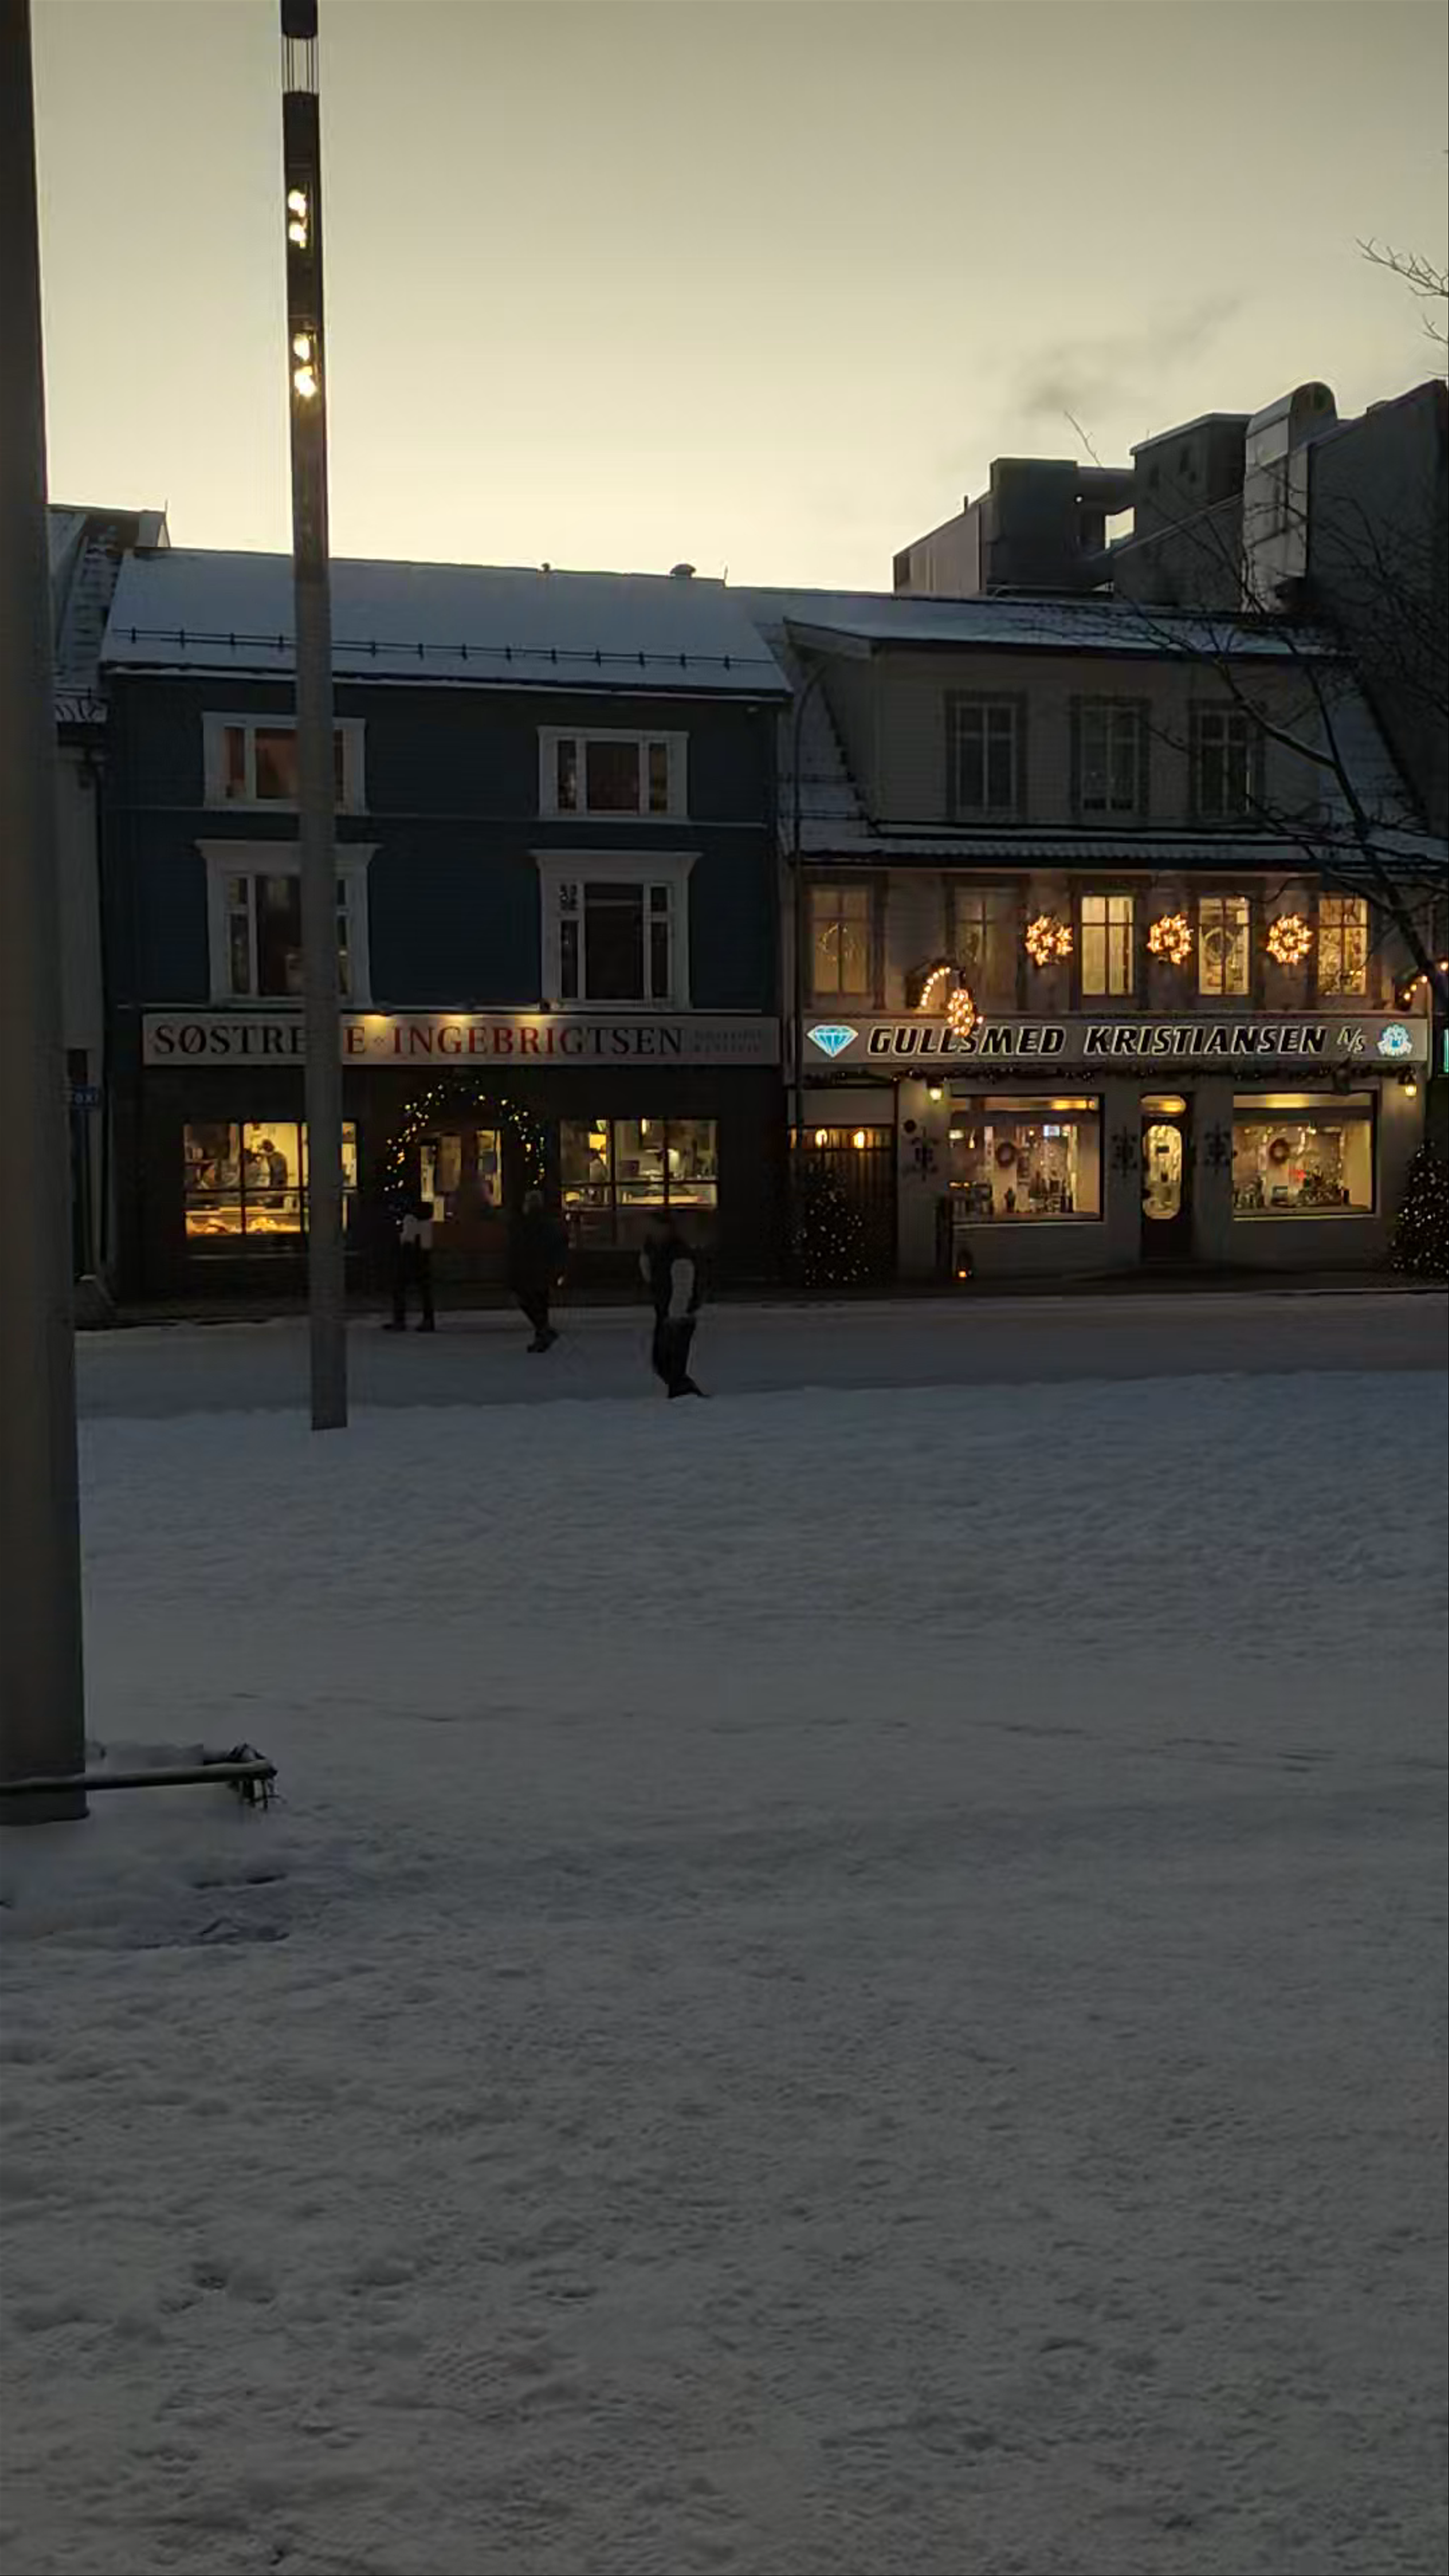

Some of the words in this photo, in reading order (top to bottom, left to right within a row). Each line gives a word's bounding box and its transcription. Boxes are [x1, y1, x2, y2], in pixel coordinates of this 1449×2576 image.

[155, 1024, 365, 1055] SØSTREE
[394, 1025, 682, 1055] INGEBRIGTSEN
[867, 1024, 1066, 1056] GULLSMED
[1083, 1024, 1327, 1055] KRISTIANSEN
